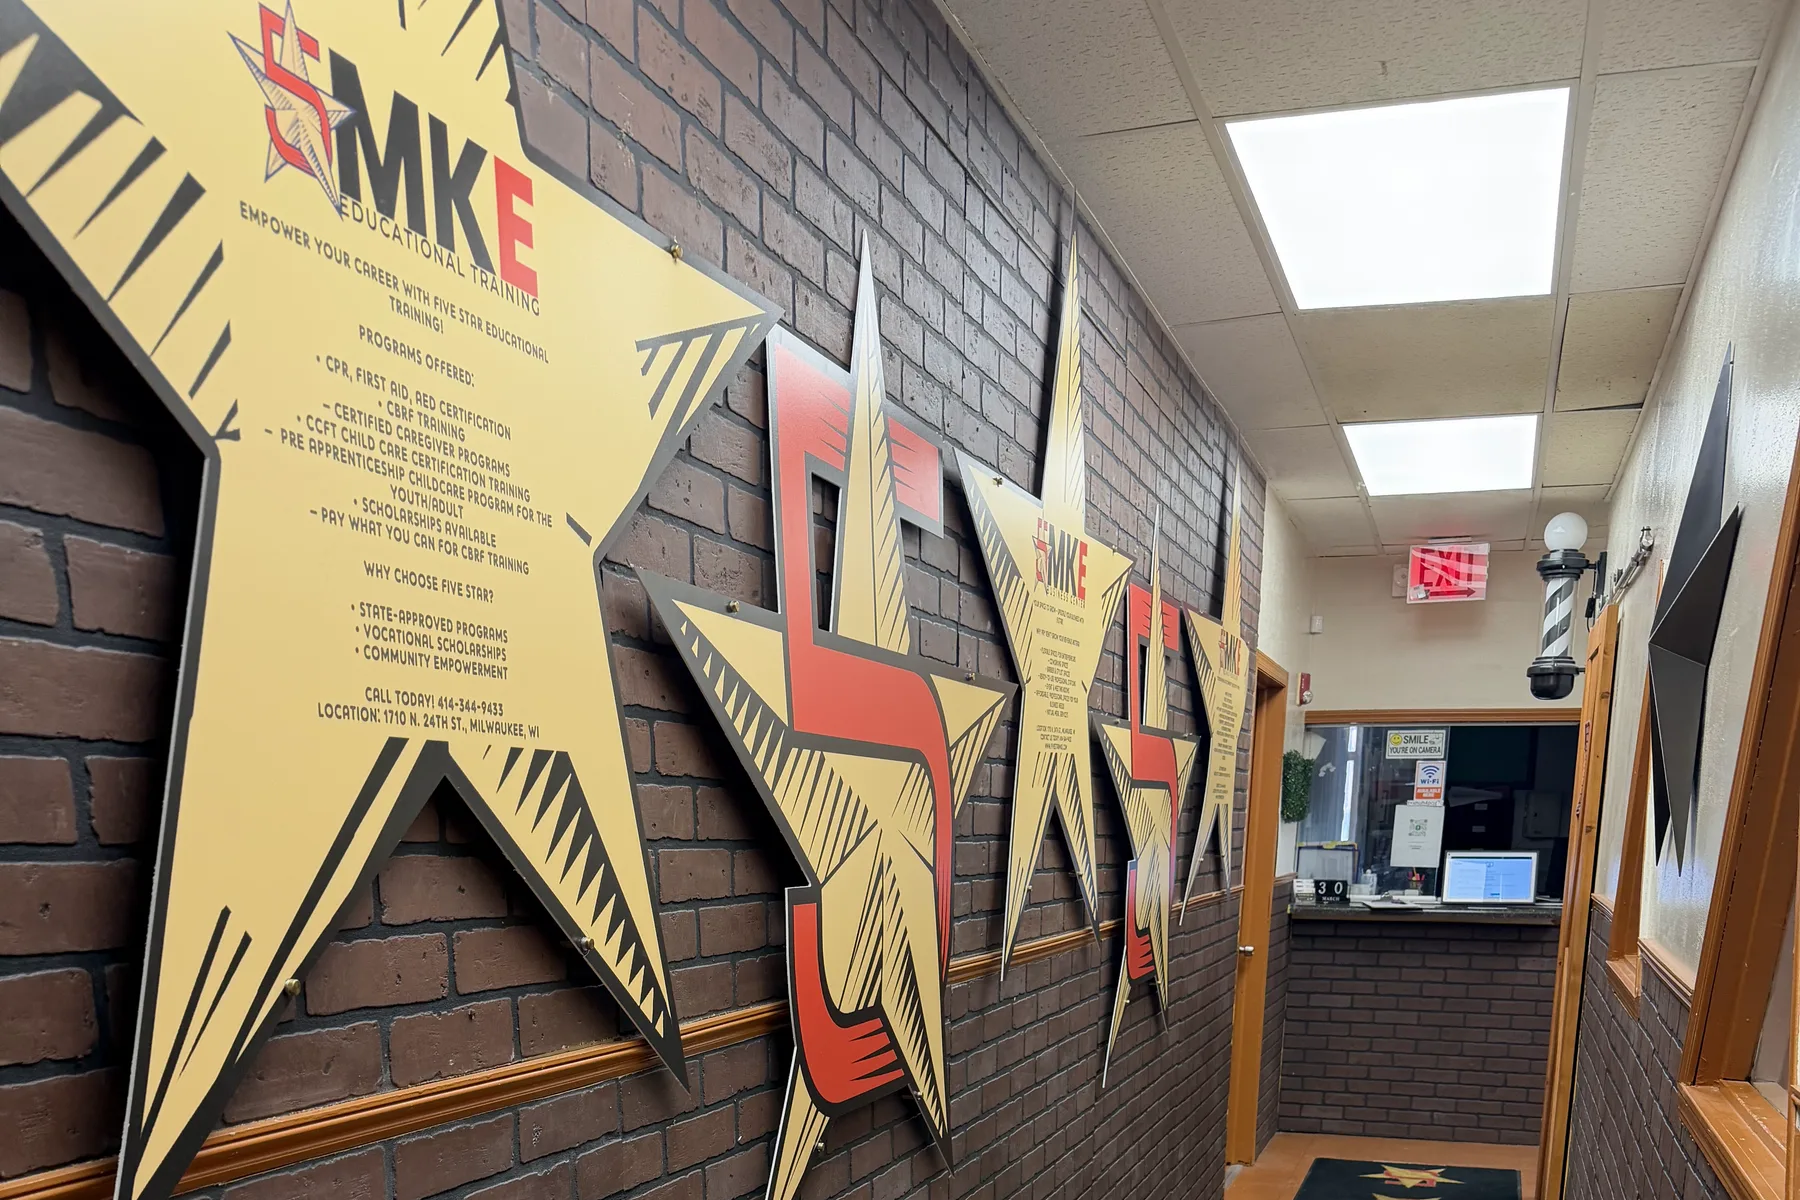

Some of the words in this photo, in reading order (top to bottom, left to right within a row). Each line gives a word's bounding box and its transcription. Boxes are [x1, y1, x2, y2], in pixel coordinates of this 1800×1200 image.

[340, 193, 465, 278] EDUCATIONAL
[470, 263, 540, 317] TRAINING
[239, 200, 311, 250] EMPOWER
[314, 236, 351, 269] YOUR
[354, 257, 400, 292] CAREER
[402, 279, 430, 307] WITH
[434, 296, 456, 319] FIVE
[459, 308, 483, 332] STAR
[485, 321, 549, 364] EDUCATIONAL
[389, 295, 444, 334] TRAINING!
[359, 324, 422, 365] PROGRAMS
[425, 353, 475, 387] OFFERED:
[326, 355, 353, 383] CPR,
[356, 367, 386, 392] FIRST
[390, 380, 413, 406] AID,
[415, 390, 436, 411] AED
[440, 400, 511, 440] CERTIFICATION
[334, 402, 393, 436] CERTIFIED
[396, 424, 455, 458] CAREGIVER
[458, 446, 511, 477] PROGRAMS
[387, 400, 414, 422] CBRF
[417, 411, 466, 442] TRAINING
[281, 428, 304, 451] PRE
[309, 437, 405, 481] APPRENTICESHIP
[409, 470, 465, 500] CHILDCARE
[468, 488, 514, 516] PROGRAM
[516, 505, 534, 522] FOR
[536, 510, 552, 528] THE
[306, 414, 337, 438] CCFT
[341, 426, 375, 451] CHILD
[379, 439, 408, 462] CARE
[412, 450, 486, 488] CERTIFICATION
[488, 476, 530, 502] TRAINING
[362, 497, 441, 533] SCHOLARSHIPS
[445, 521, 496, 548] AVAILABLE
[390, 484, 464, 519] YOUTH/ADULT
[321, 506, 345, 527] PAY
[348, 514, 382, 537] WHAT
[385, 524, 410, 544] YOU
[414, 532, 435, 551] CAN
[438, 538, 458, 557] FOR
[461, 545, 485, 563] CBRF
[487, 551, 529, 575] TRAINING
[363, 560, 390, 580] WHY
[394, 567, 439, 591] CHOOSE
[441, 579, 463, 597] FIVE
[466, 584, 494, 603] STAR?
[359, 601, 453, 633] STATE-APPROVED
[456, 620, 508, 643] PROGRAMS
[363, 623, 434, 650] VOCATIONAL
[437, 636, 507, 662] SCHOLARSHIPS
[363, 644, 431, 668] COMMUNITY
[433, 655, 508, 680] EMPOWERMENT
[317, 702, 381, 723] LOCATION:
[383, 709, 407, 726] 1710
[410, 712, 420, 727] N.
[423, 713, 448, 730] 24TH
[470, 718, 527, 739] MILWAUKEE,
[528, 724, 540, 739] WI
[365, 686, 392, 704] CALL
[395, 690, 435, 709] TODAY!
[437, 696, 504, 717] 414-344-9433
[1403, 735, 1429, 745] SMILE
[1409, 746, 1418, 754] ON
[1418, 746, 1441, 754] CAMERA
